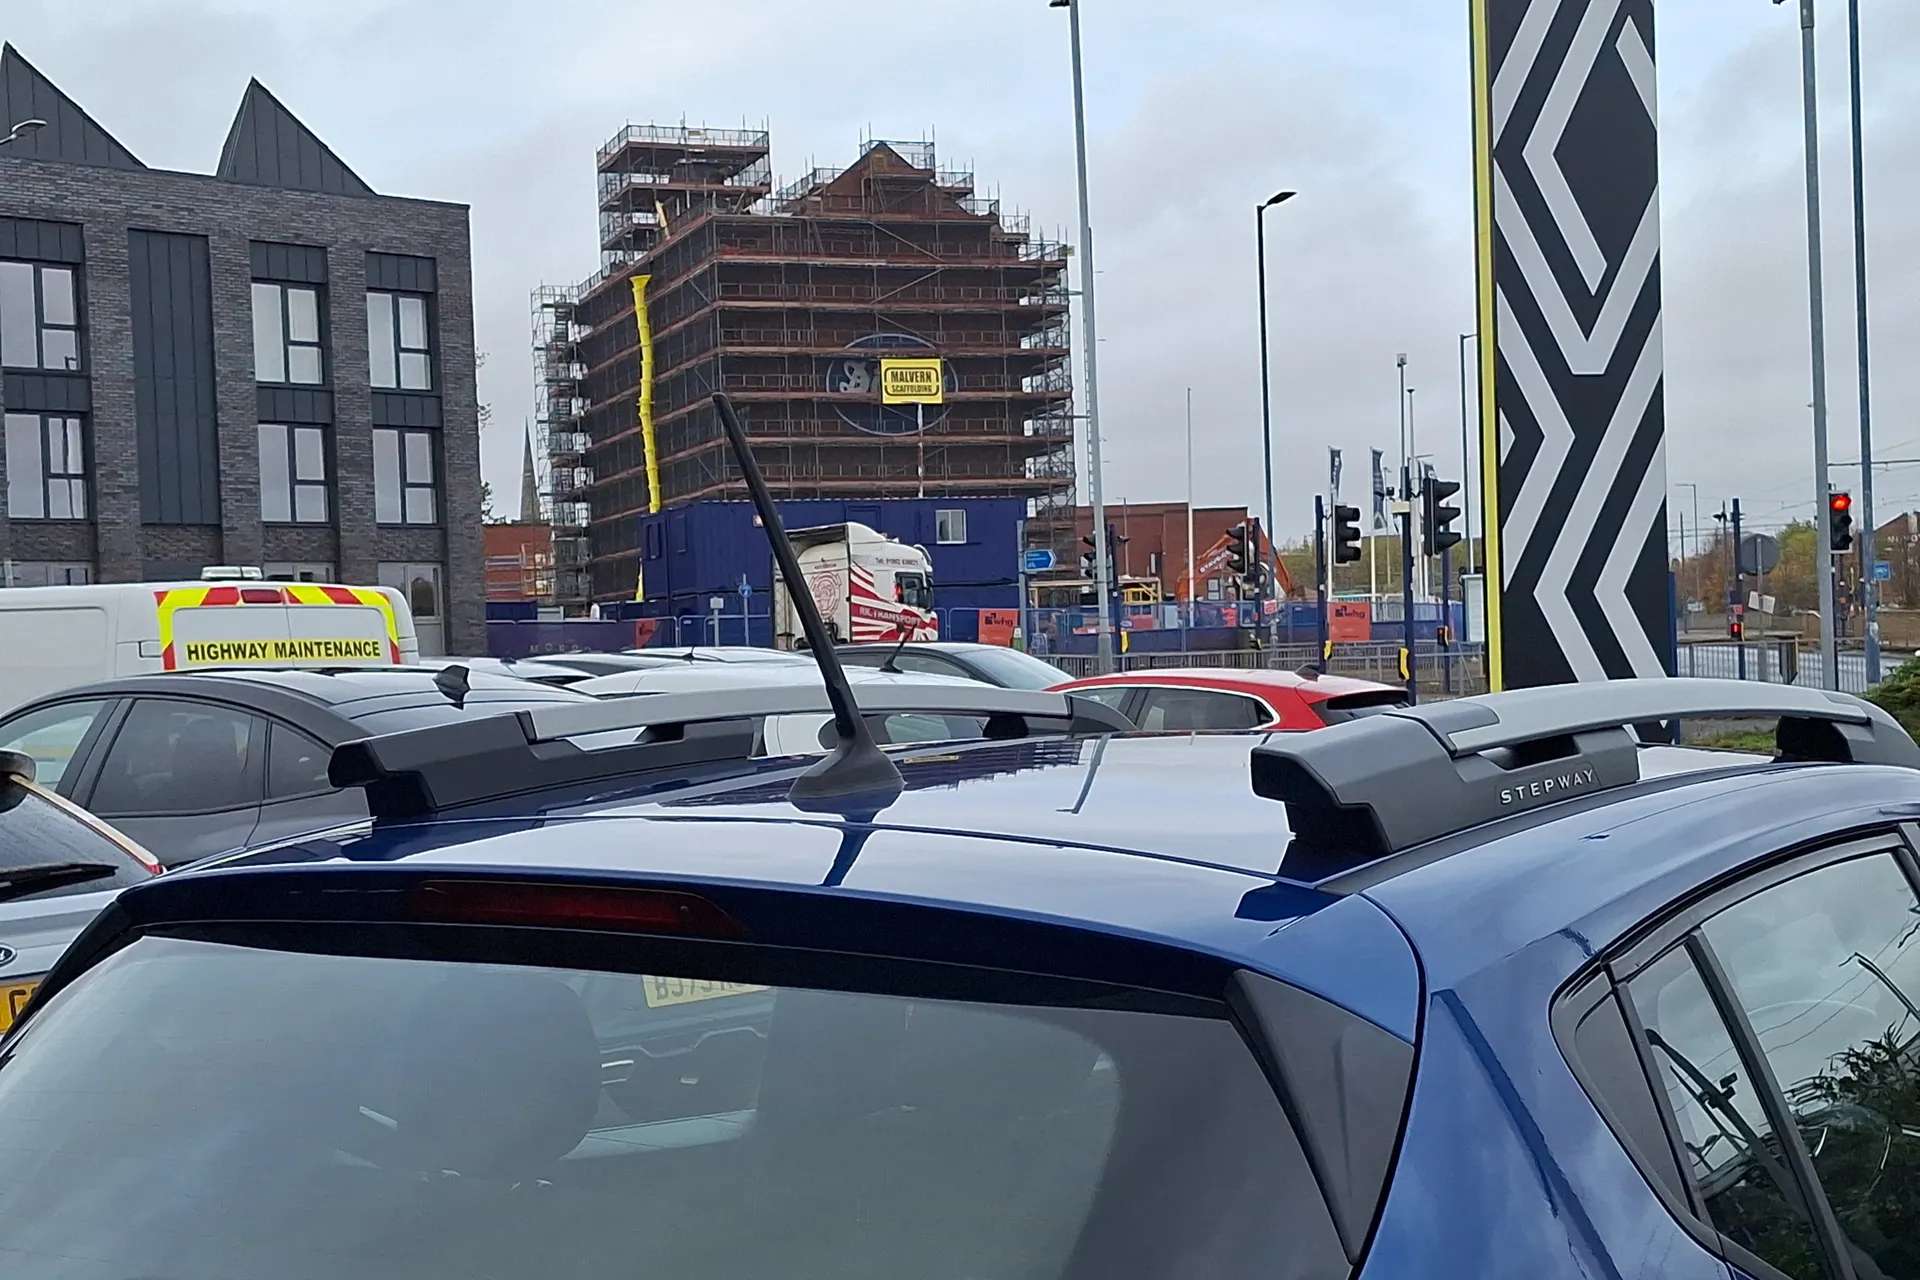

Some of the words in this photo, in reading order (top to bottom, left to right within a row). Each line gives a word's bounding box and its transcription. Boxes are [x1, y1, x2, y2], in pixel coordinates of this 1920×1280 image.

[890, 370, 932, 383] MALVERN
[891, 384, 933, 392] SCAFFOLDING
[873, 609, 921, 626] TRANSPORT
[187, 641, 269, 661] HIGHWAY
[274, 640, 381, 660] MAINTENANCE
[1500, 768, 1593, 804] STEPWAY
